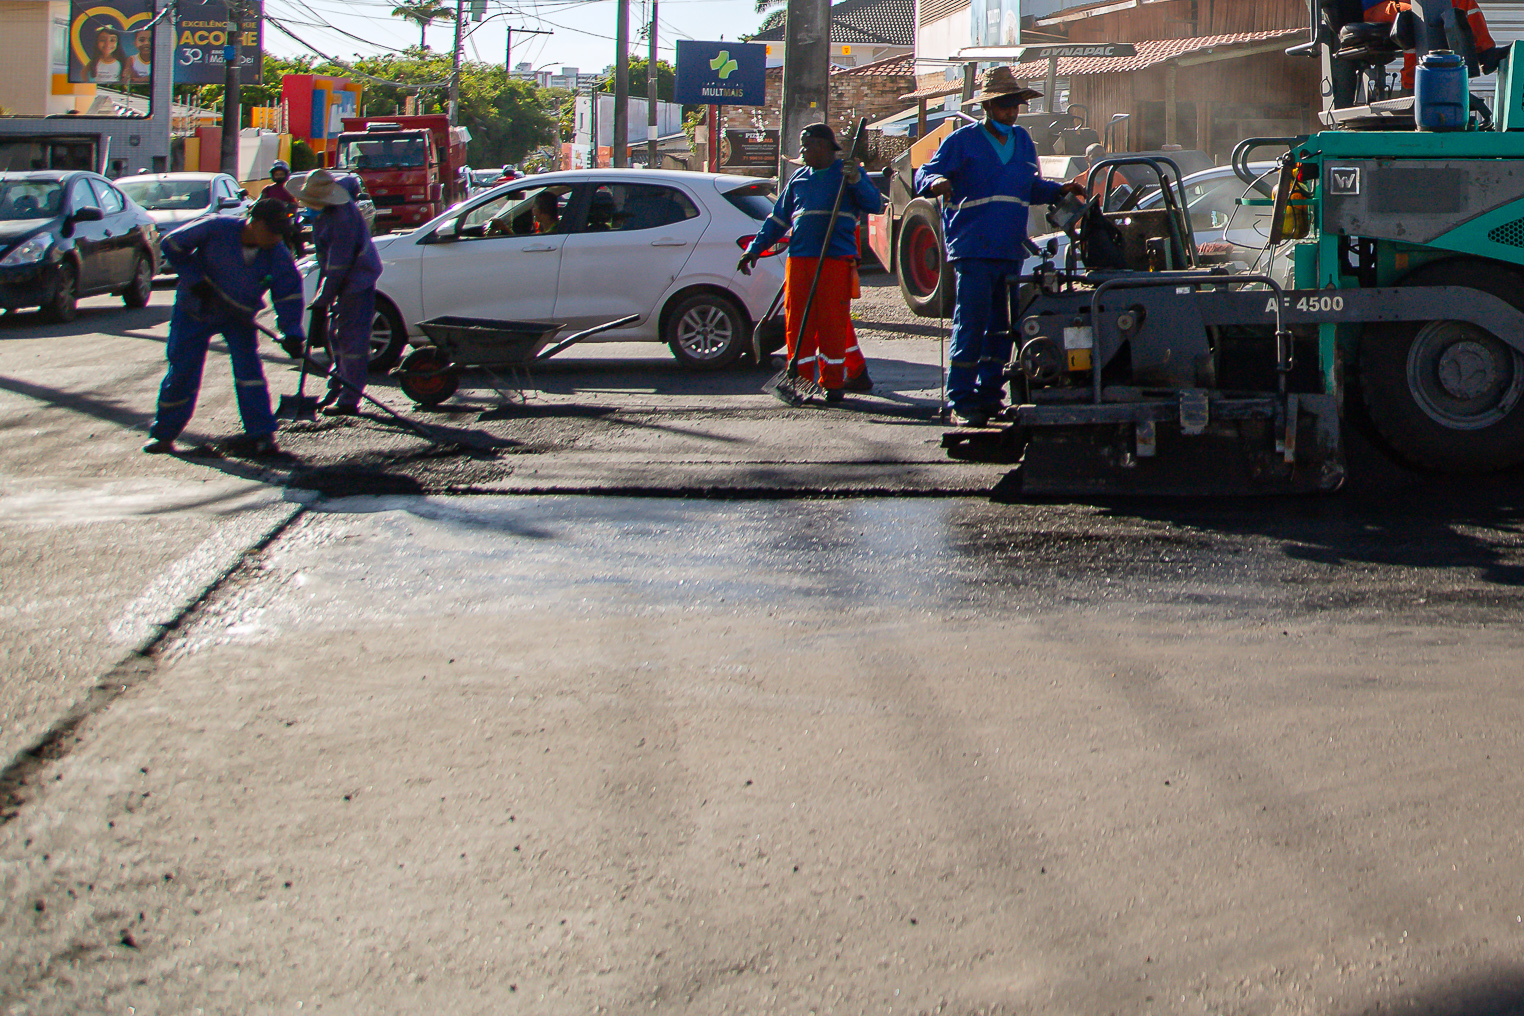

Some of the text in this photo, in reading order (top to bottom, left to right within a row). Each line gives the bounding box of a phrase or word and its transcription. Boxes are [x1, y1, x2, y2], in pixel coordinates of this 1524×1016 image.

[1040, 46, 1115, 57] DYNAPAC
[702, 87, 744, 98] MULTMAIS
[1296, 296, 1344, 312] 4500
